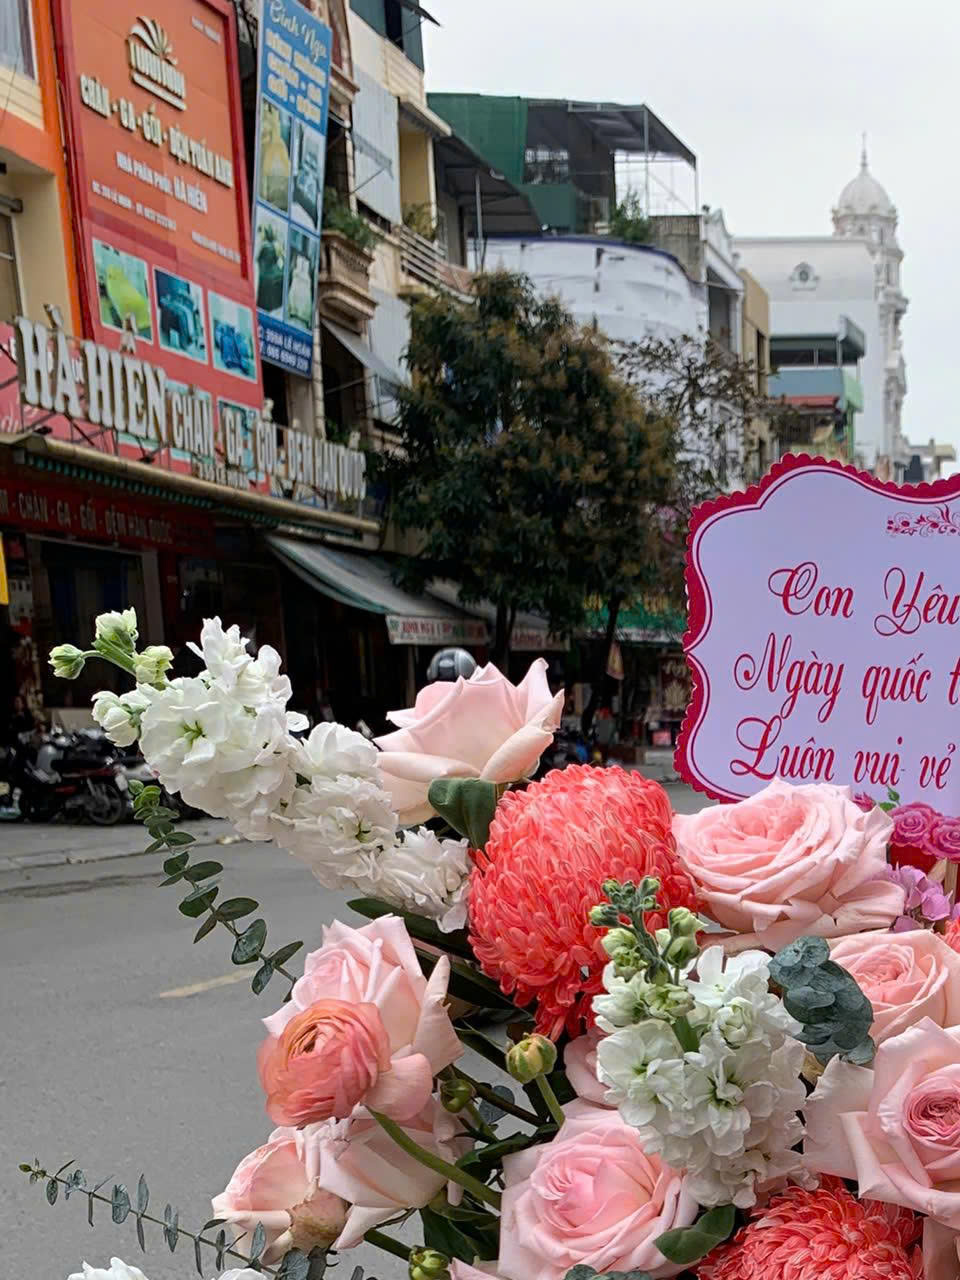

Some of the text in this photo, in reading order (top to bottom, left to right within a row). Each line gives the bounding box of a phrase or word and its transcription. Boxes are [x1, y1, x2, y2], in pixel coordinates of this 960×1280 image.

[18, 304, 82, 418] HÀ
[225, 407, 244, 466] GA
[768, 561, 854, 619] Con
[874, 567, 960, 637] Yêu
[734, 633, 843, 723] Ngày
[861, 652, 932, 725] quốc
[730, 715, 835, 783] Luôn
[854, 736, 904, 786] vui
[920, 744, 956, 789] vẻ
